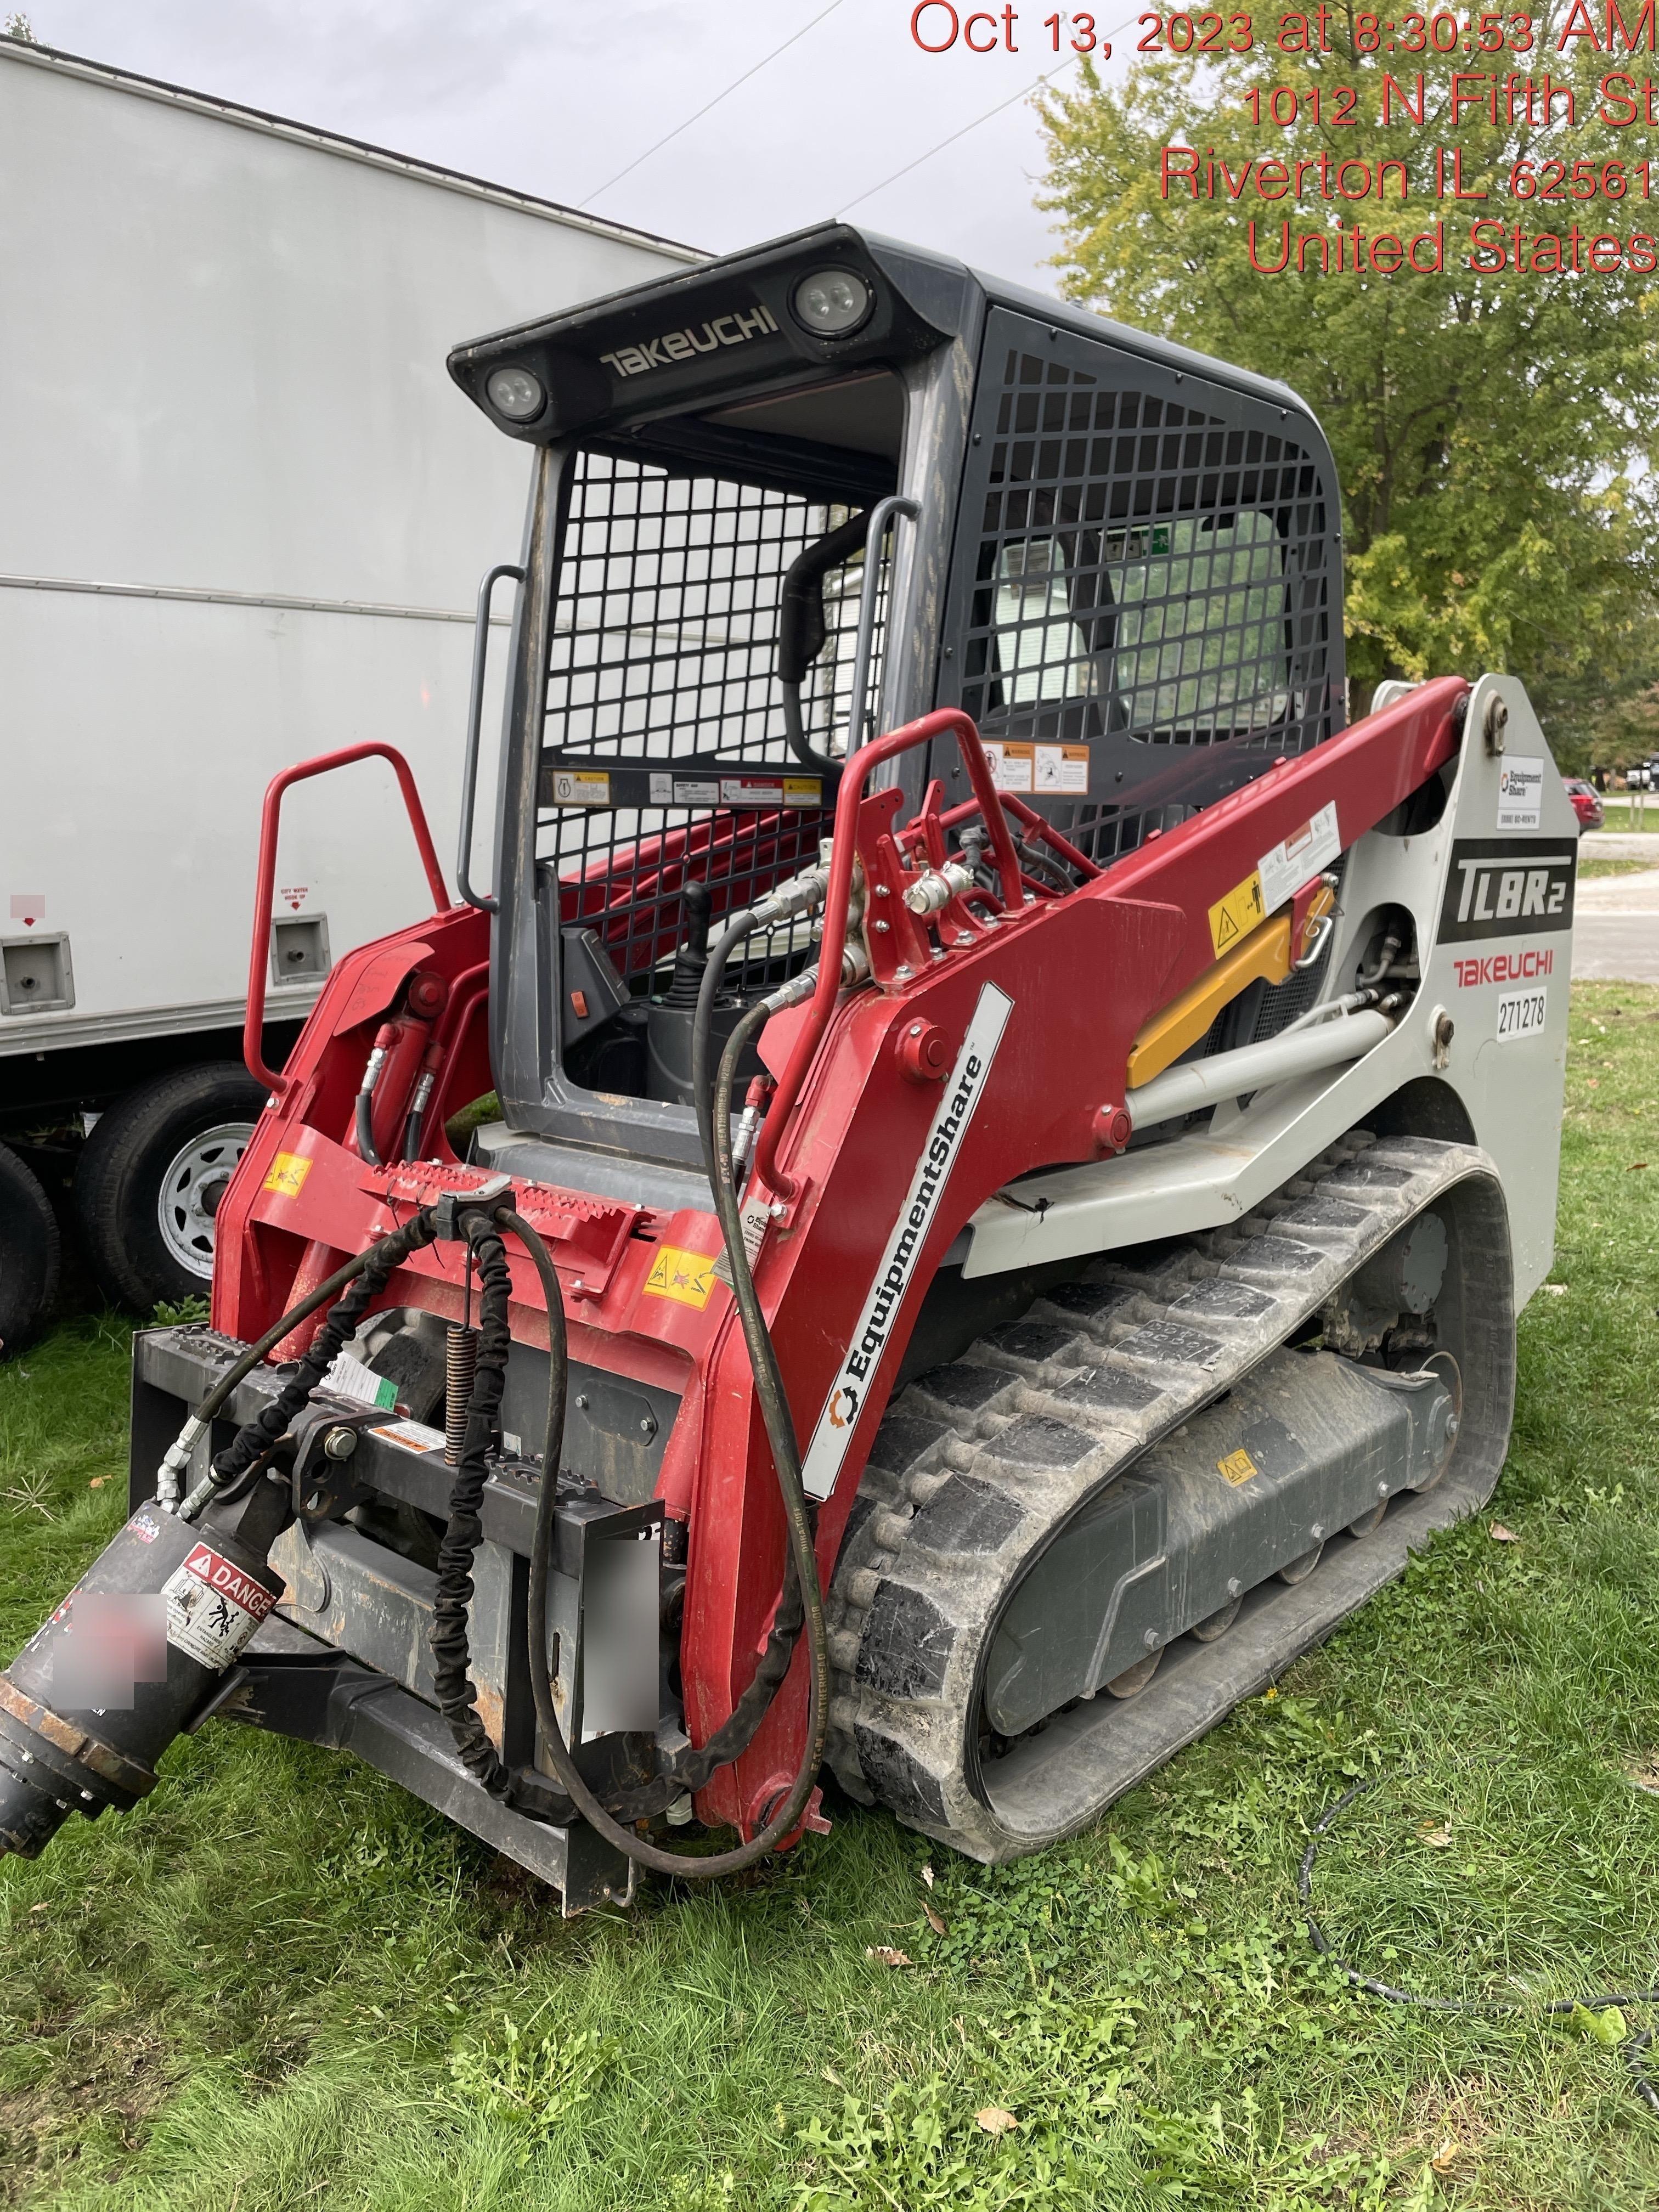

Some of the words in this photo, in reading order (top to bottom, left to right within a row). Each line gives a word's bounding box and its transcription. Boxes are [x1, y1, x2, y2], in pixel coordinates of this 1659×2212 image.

[1509, 785, 1526, 796] Share
[1510, 770, 1541, 786] Equipment
[1499, 996, 1545, 1034] 271278
[716, 1087, 727, 1147] WEATHERHEAD
[846, 1054, 982, 1381] EquipmentShare
[793, 1507, 809, 1553] DURA-TUFF
[211, 1565, 272, 1617] DANGE
[816, 1653, 828, 1730] WEATHERHEAD
